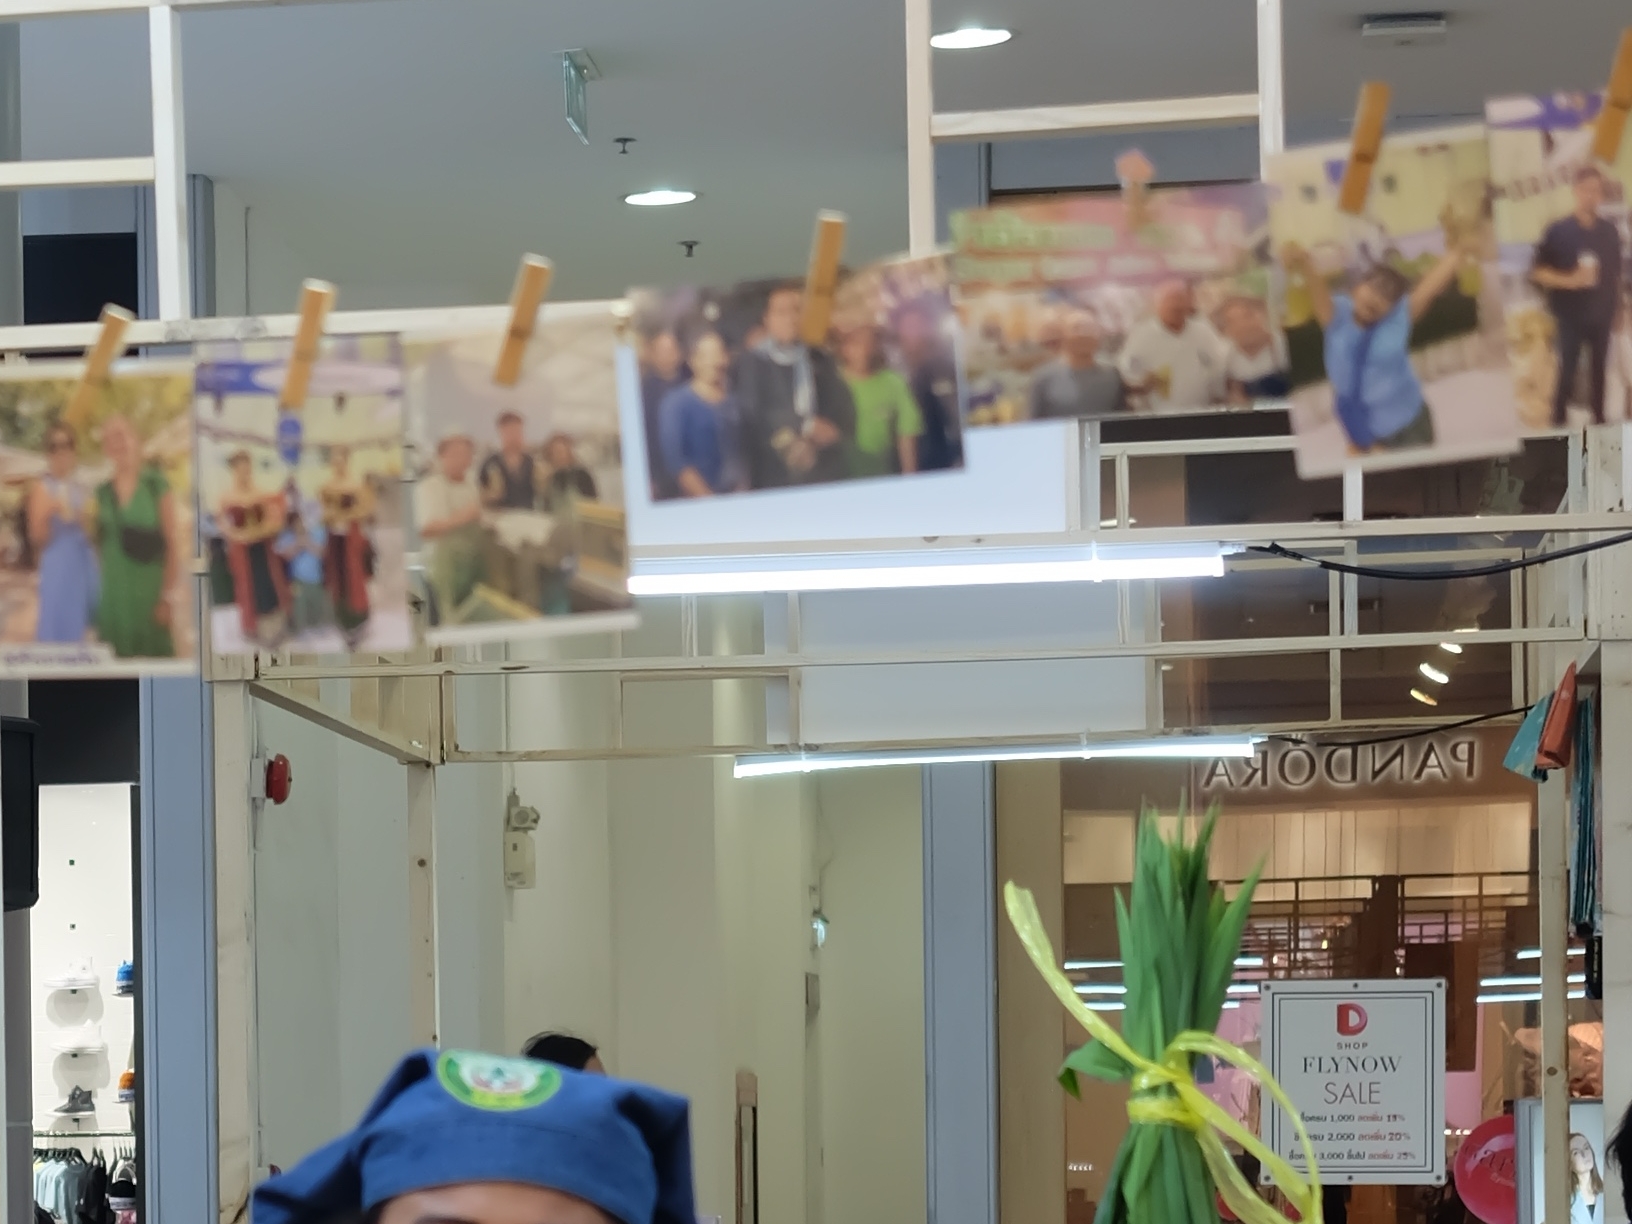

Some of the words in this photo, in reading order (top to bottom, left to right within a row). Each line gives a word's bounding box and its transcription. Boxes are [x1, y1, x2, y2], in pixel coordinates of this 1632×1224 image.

[1336, 1003, 1368, 1036] D
[1336, 1042, 1369, 1050] SHOP
[1302, 1055, 1403, 1074] FLYNOW
[1324, 1081, 1382, 1105] SALE
[1330, 1114, 1355, 1123] 1,000
[1328, 1132, 1356, 1141] 2,000
